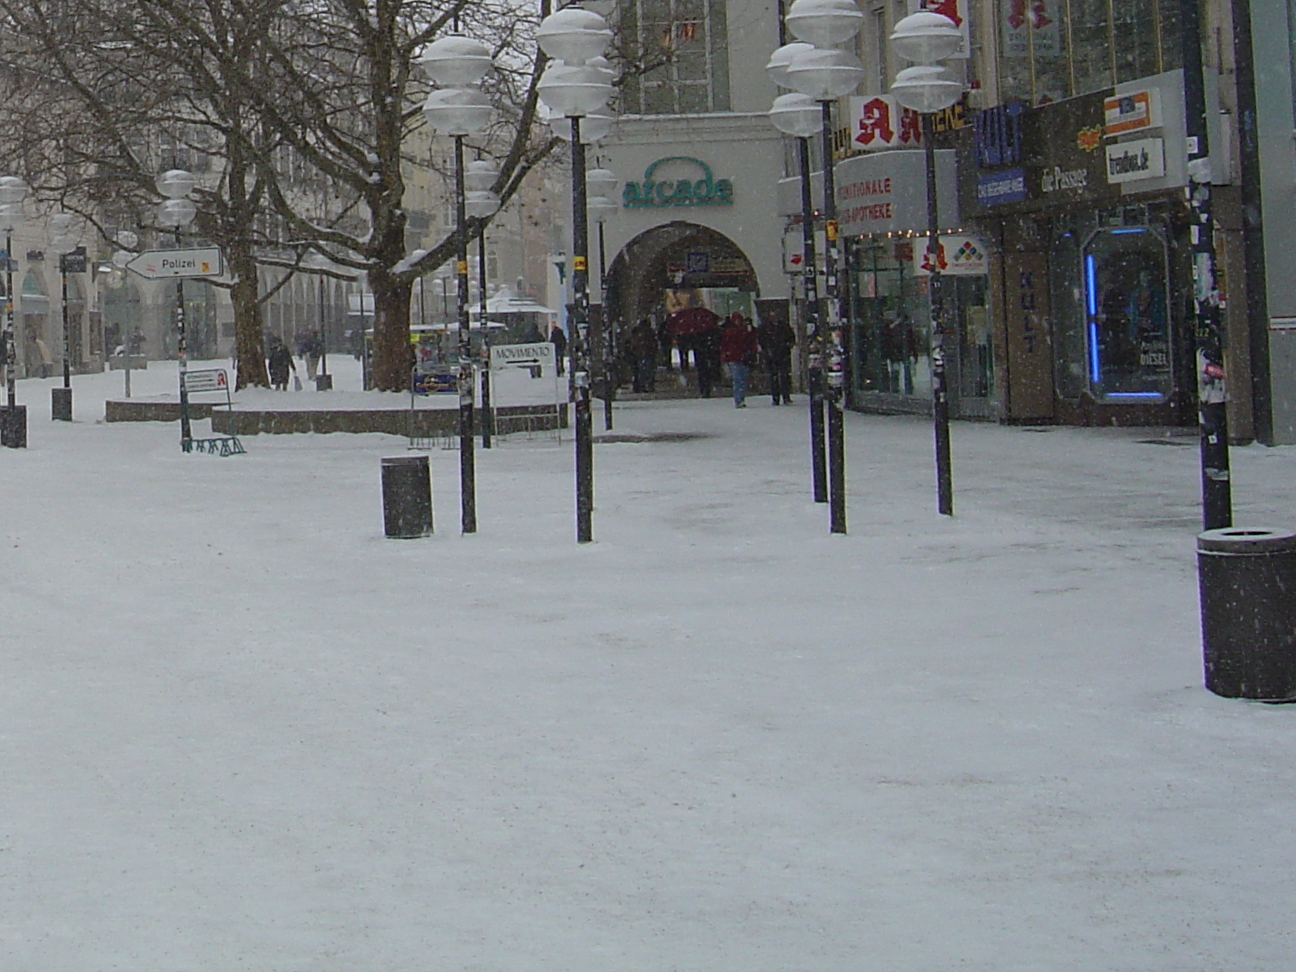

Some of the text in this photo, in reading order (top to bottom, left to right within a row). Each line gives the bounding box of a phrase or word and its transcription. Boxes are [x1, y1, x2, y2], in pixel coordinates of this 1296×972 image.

[622, 156, 733, 201] arcade
[162, 258, 196, 269] Polizei
[495, 346, 551, 360] MOVIMENTO
[1140, 352, 1167, 366] DIESEL
